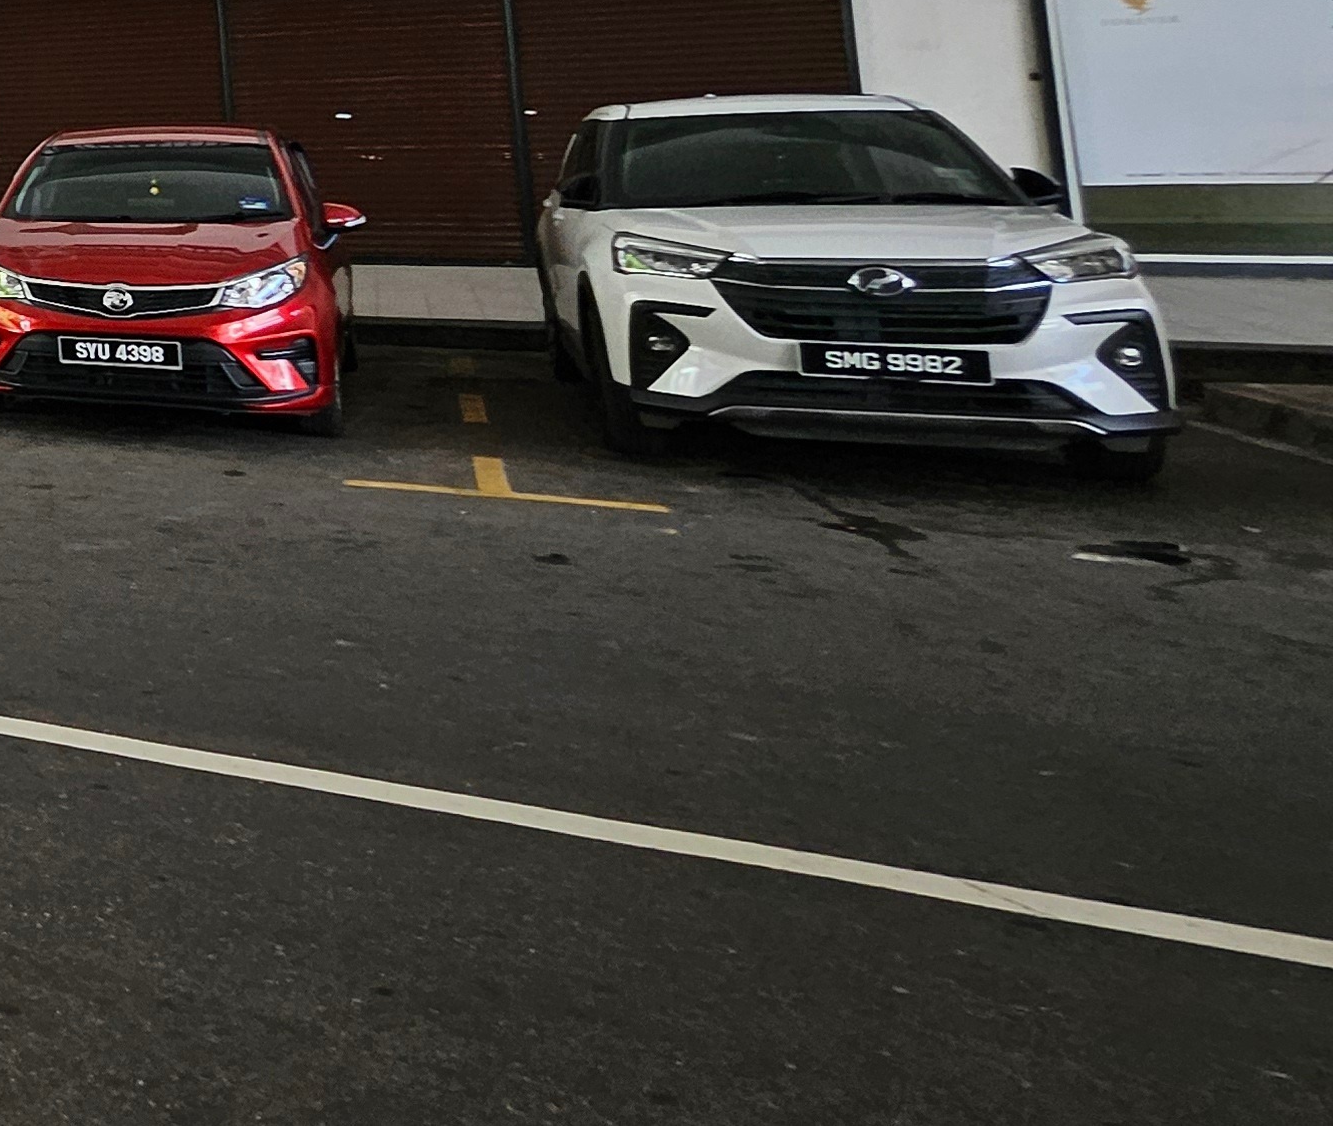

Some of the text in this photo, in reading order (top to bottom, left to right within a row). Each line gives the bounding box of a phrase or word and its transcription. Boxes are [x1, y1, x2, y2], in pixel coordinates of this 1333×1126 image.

[75, 341, 165, 363] SYU 4398
[825, 350, 963, 375] SMG 9982
